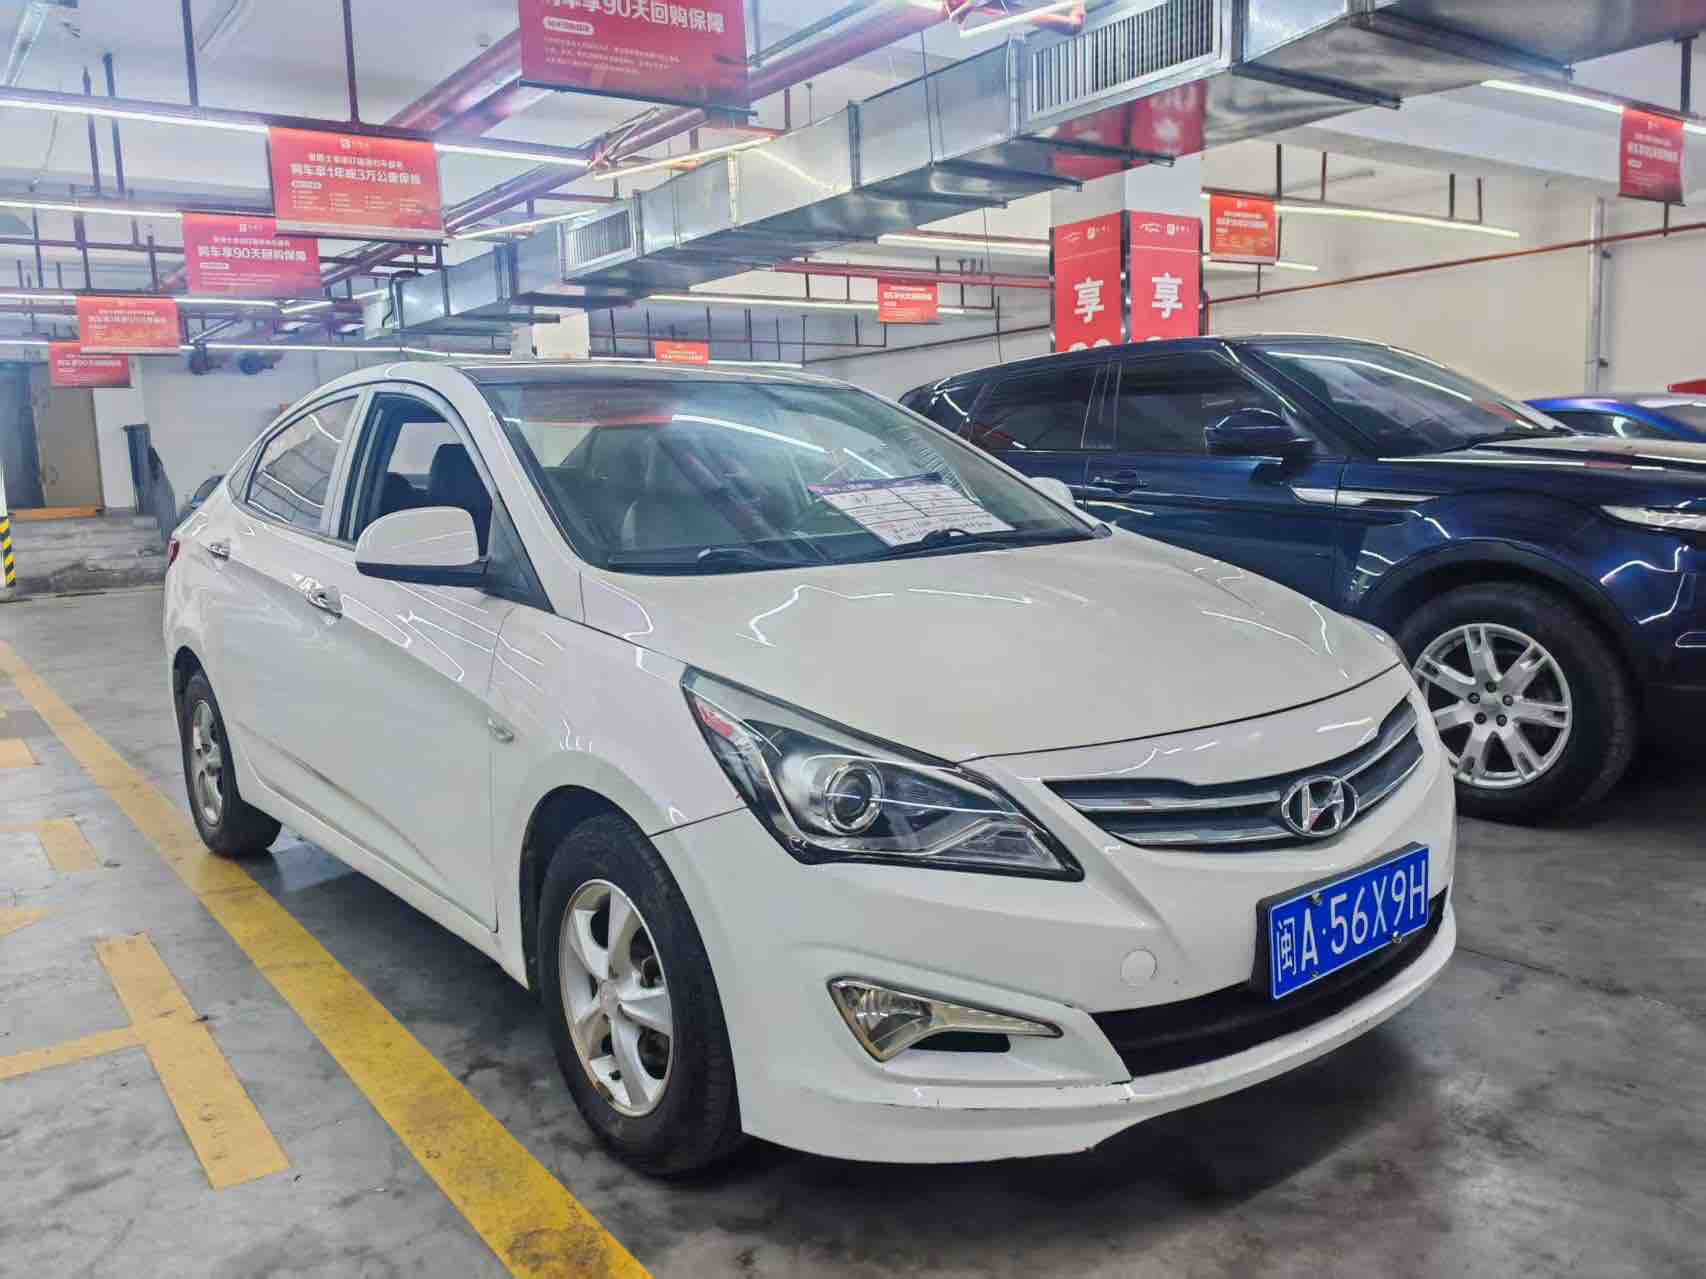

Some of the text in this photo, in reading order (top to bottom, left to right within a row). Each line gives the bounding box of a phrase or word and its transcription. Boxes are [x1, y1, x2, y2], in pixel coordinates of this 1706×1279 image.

[544, 0, 726, 33] 享90天回购保障
[1073, 275, 1105, 325] 享
[1151, 271, 1184, 320] 享
